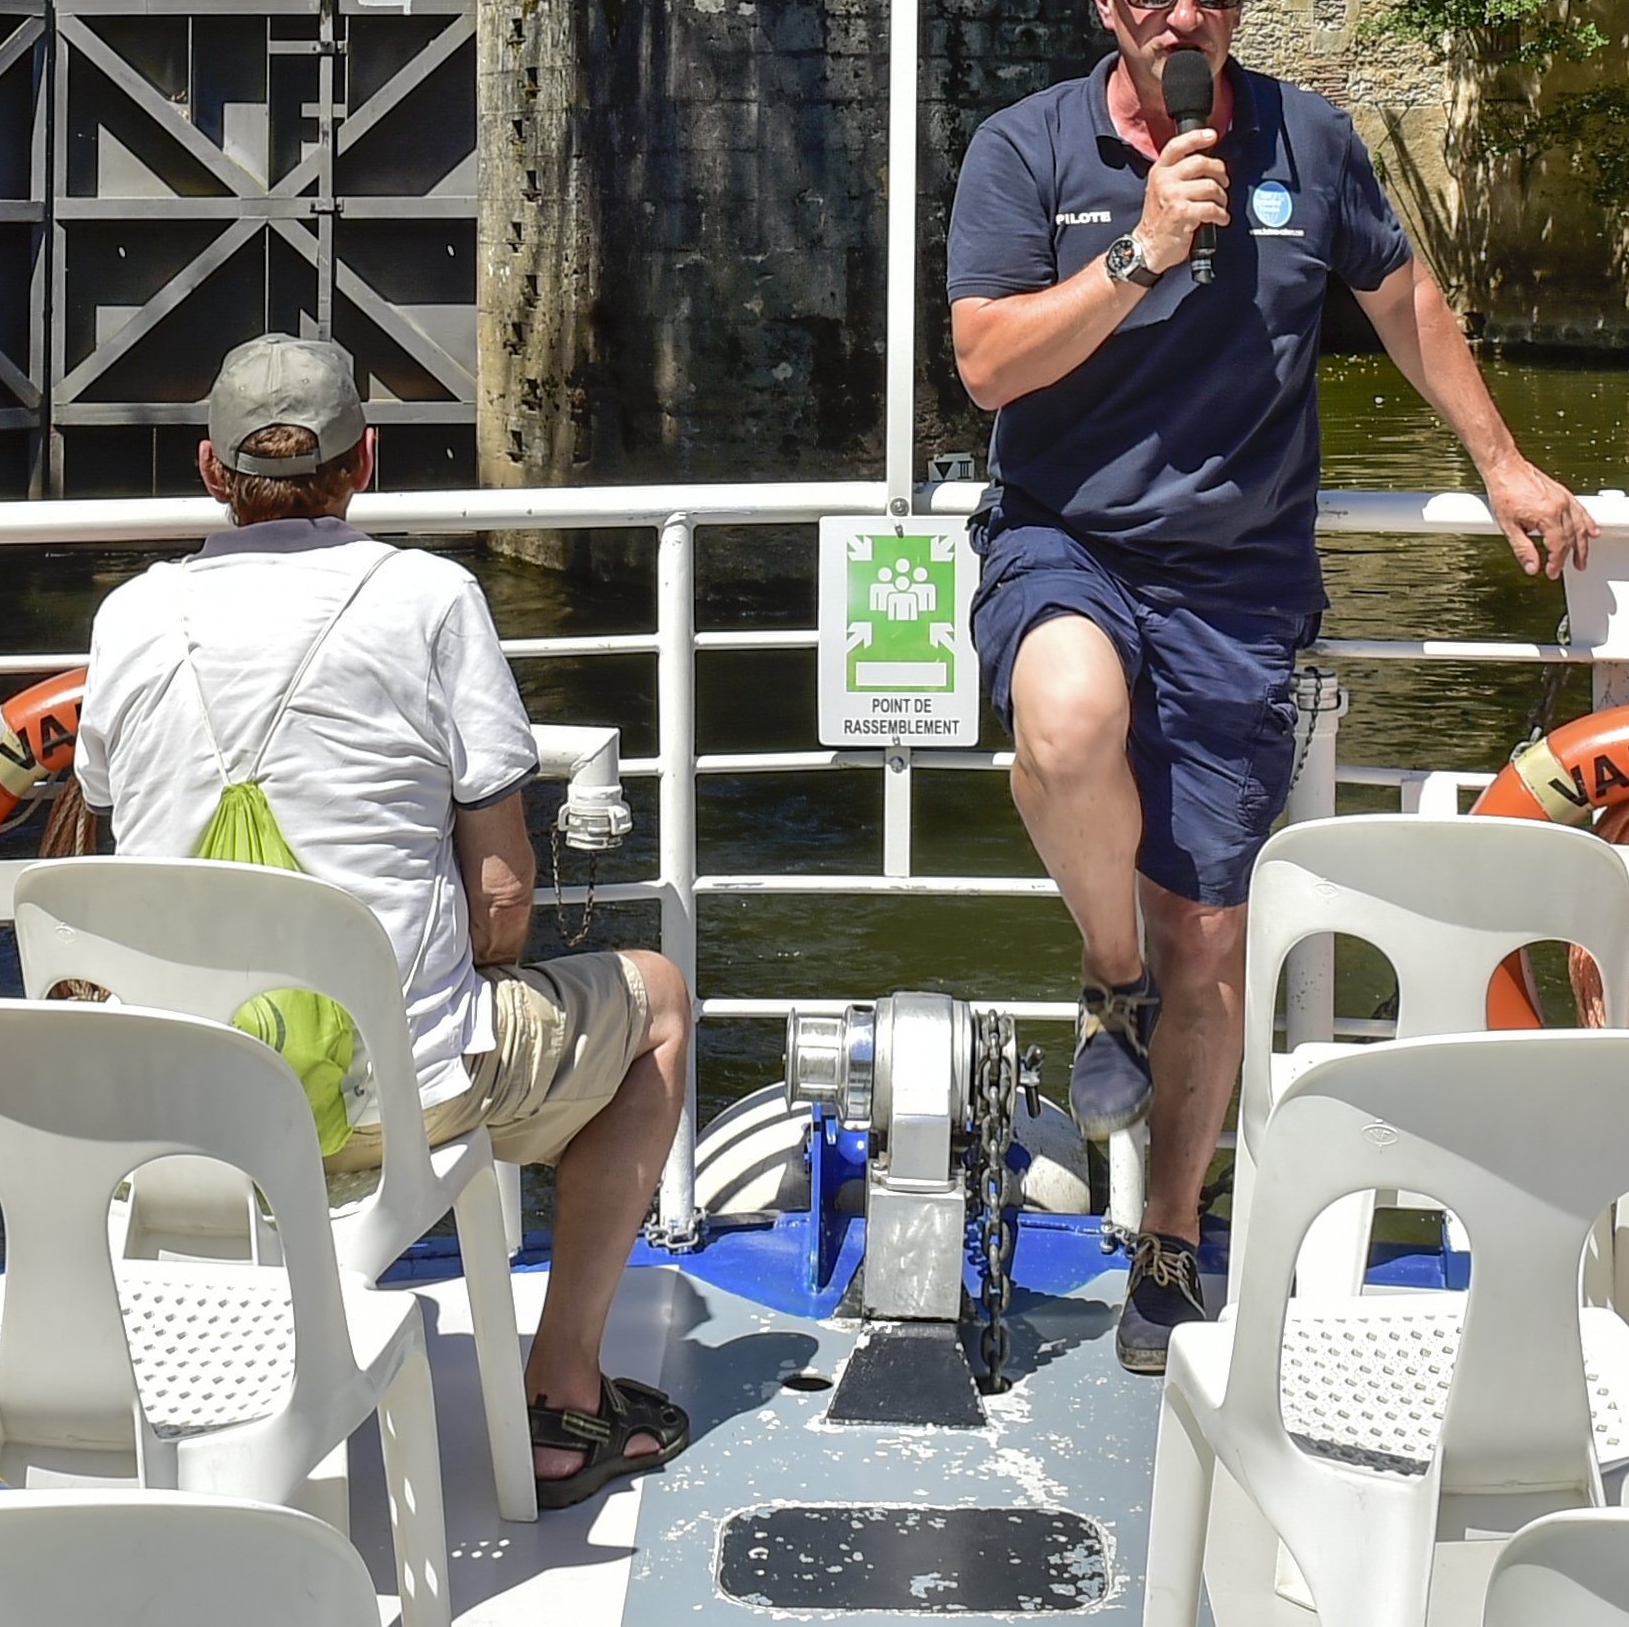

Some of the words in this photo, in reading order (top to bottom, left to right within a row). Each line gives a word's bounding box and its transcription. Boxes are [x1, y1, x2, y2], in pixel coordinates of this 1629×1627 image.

[1056, 211, 1112, 225] PILOTE
[871, 698, 911, 713] POINT
[914, 698, 932, 713] DE
[844, 720, 960, 735] RASSEMBLEMENT
